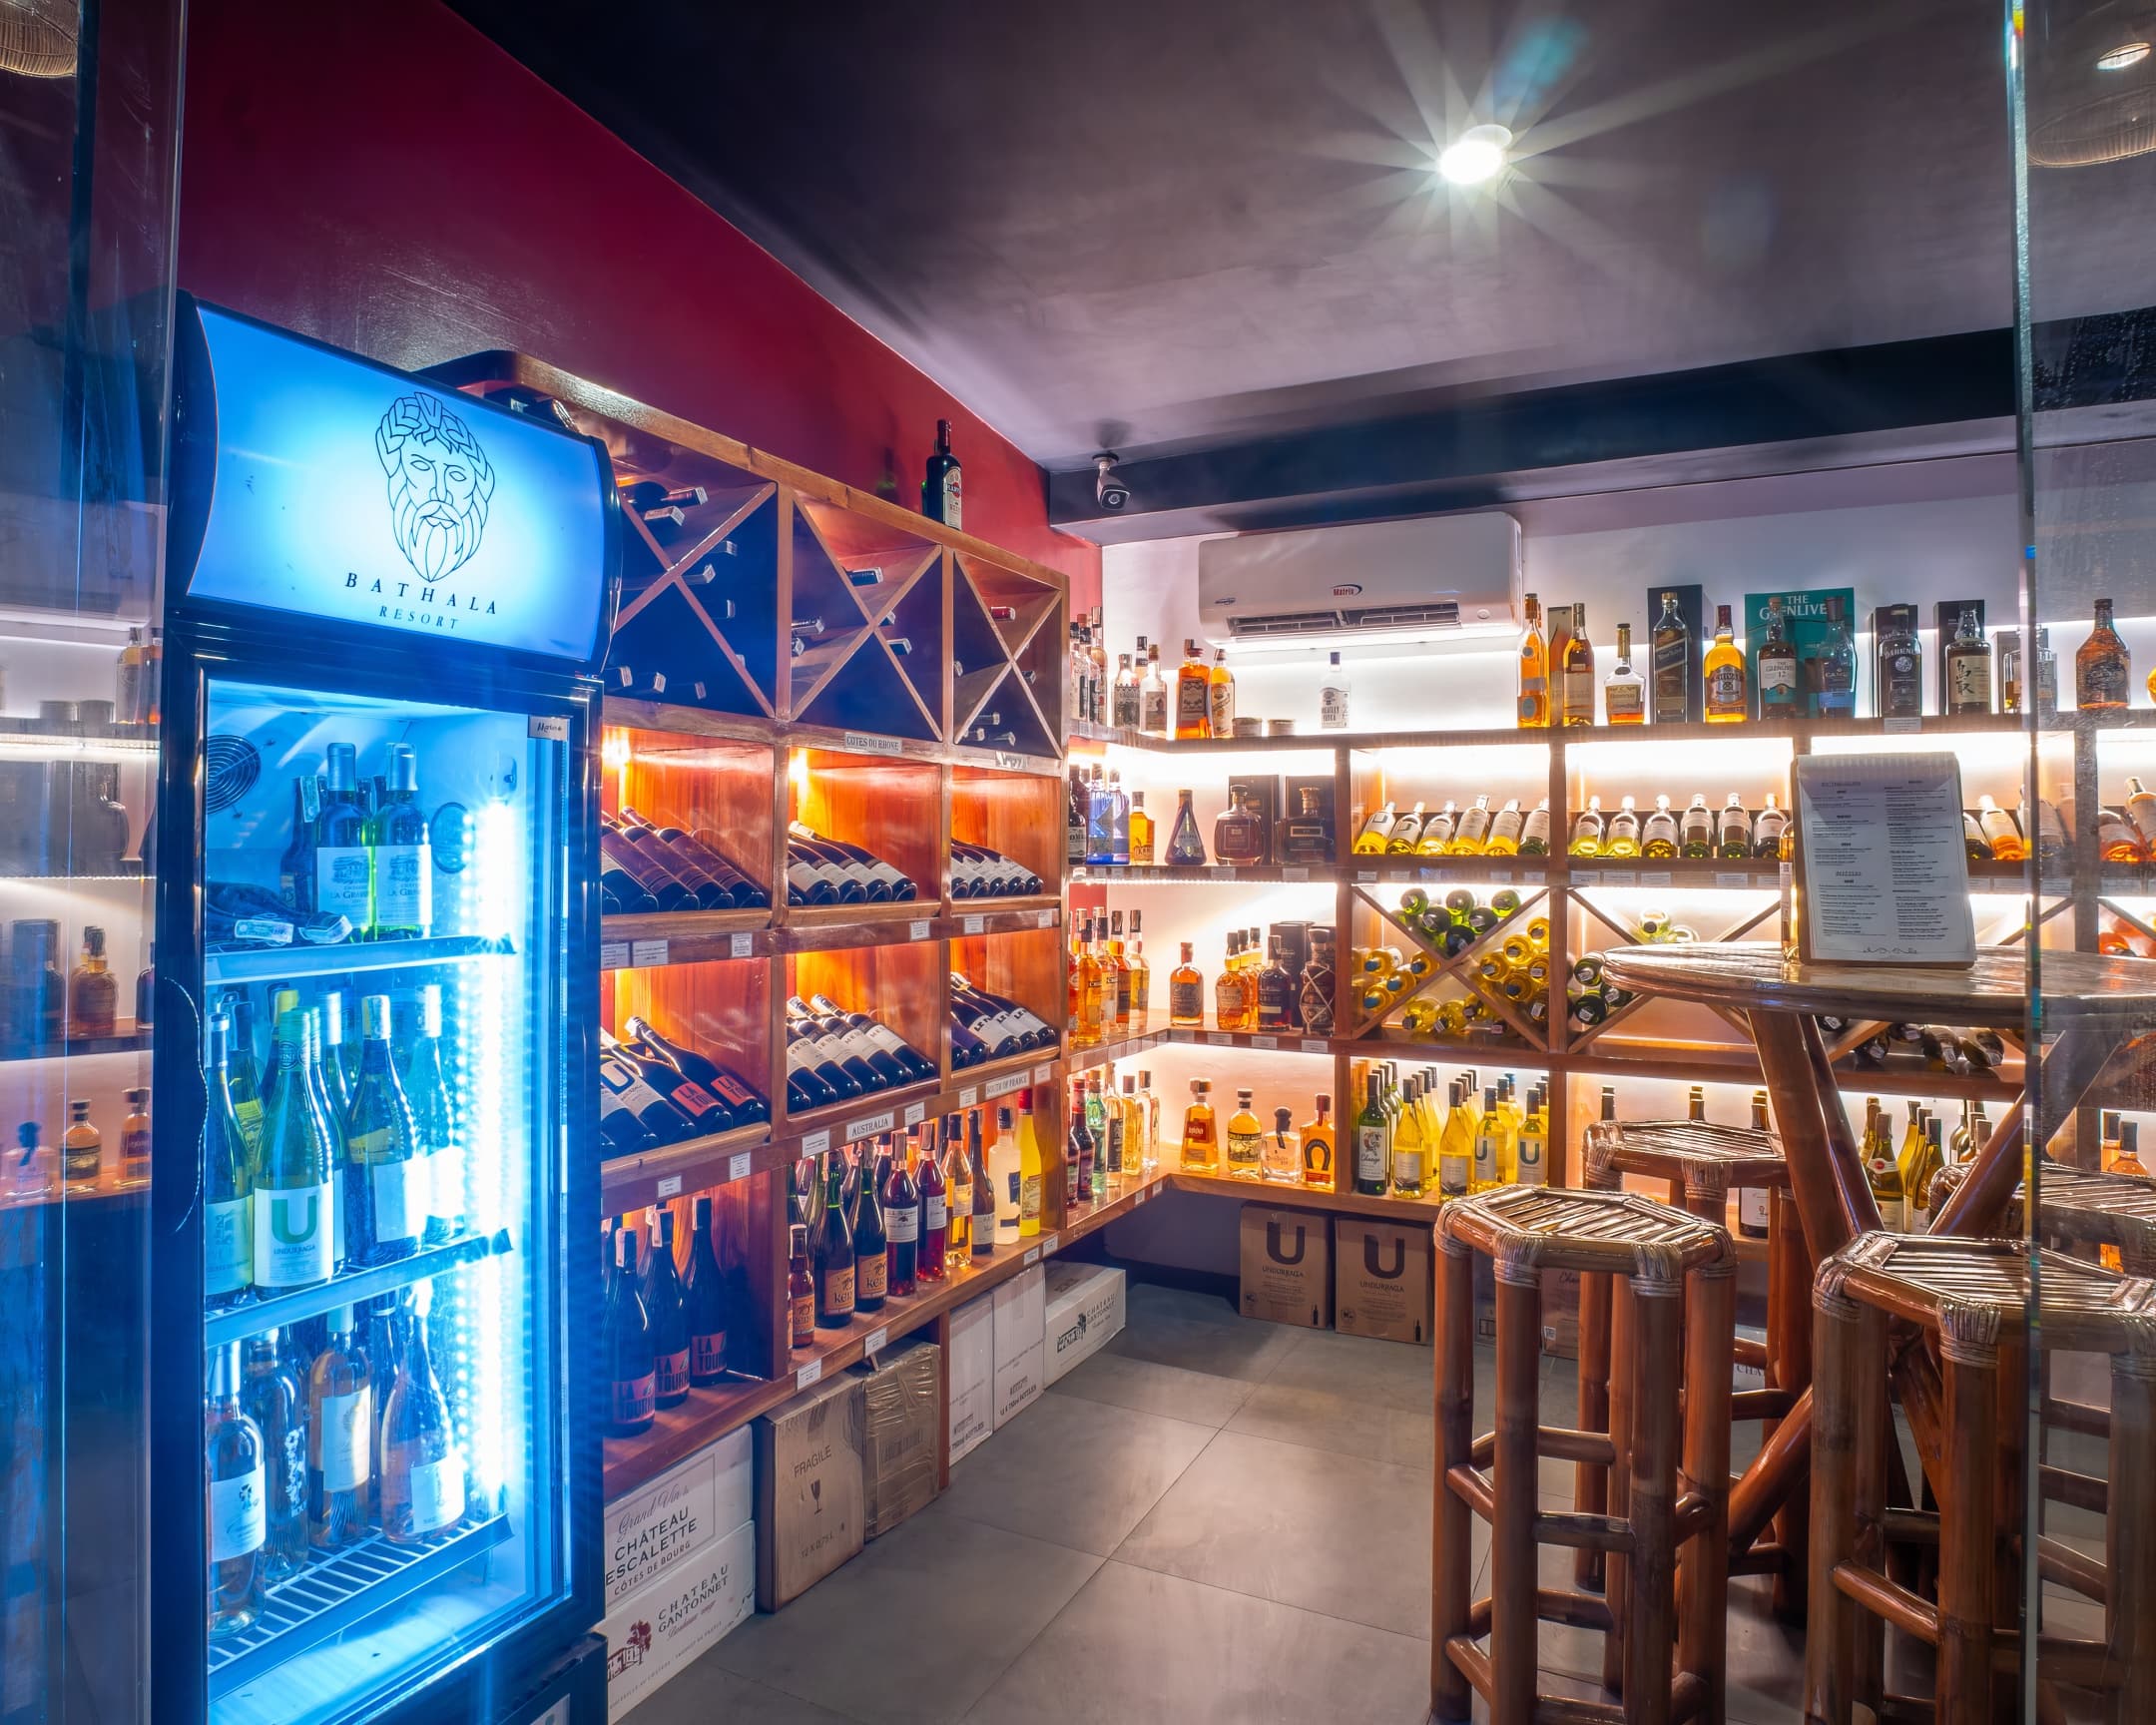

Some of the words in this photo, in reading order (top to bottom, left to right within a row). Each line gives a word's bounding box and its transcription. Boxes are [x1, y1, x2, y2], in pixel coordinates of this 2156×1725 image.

[344, 572, 497, 616] BATHALA
[1759, 604, 1829, 621] GENLIVE
[1787, 595, 1811, 605] THE
[378, 605, 460, 631] RESORT
[868, 738, 877, 749] DU
[851, 1117, 889, 1138] AUSTRALIA
[1519, 1142, 1540, 1165] U
[270, 1195, 318, 1245] U
[1267, 1222, 1306, 1266] U
[1363, 1234, 1405, 1280] U
[794, 1444, 832, 1478] FRAGILE
[614, 1505, 689, 1562] CHÂTEAU
[616, 1494, 657, 1543] Grand
[605, 1517, 698, 1586] ESCALETTE
[614, 1569, 645, 1596] CÔTES
[647, 1562, 659, 1575] DE
[660, 1540, 692, 1566] BOURG
[658, 1563, 729, 1621] CHATEAU
[658, 1575, 729, 1633] GANTONNET
